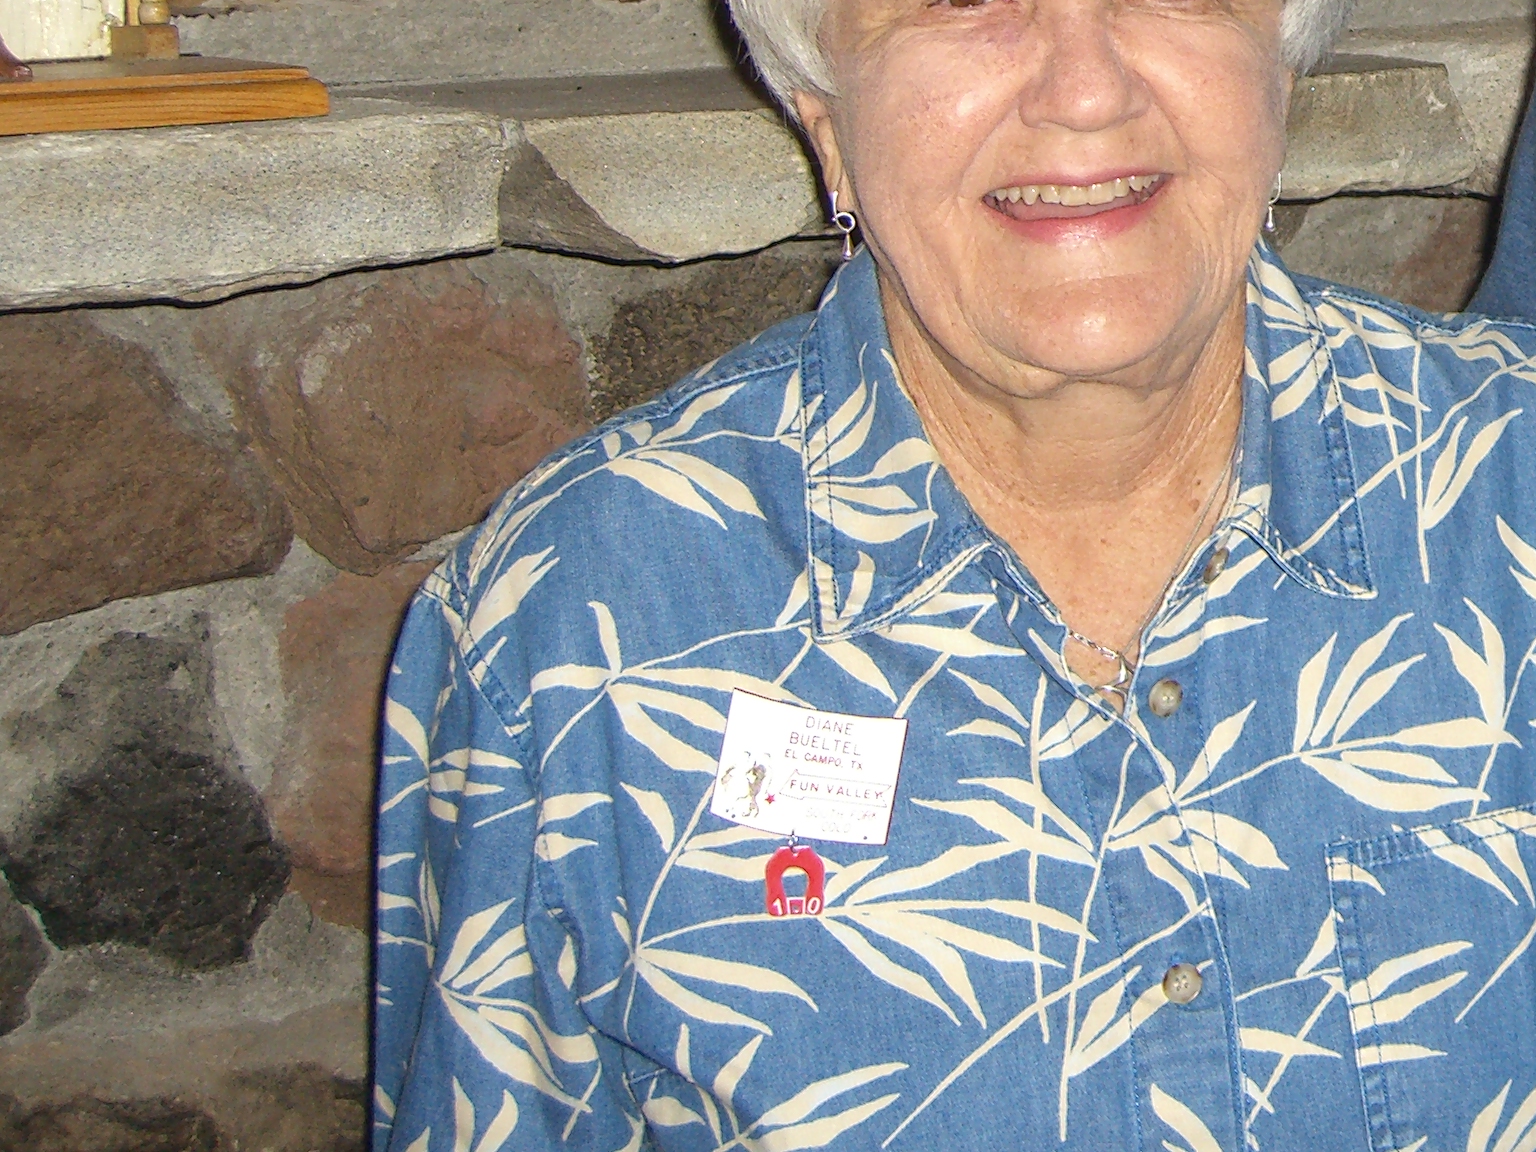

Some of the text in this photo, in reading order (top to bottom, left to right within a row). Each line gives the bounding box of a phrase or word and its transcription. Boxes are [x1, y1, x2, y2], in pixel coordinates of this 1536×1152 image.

[805, 715, 854, 736] DIANE
[789, 731, 861, 756] BUELTEL
[784, 748, 798, 759] EL
[851, 760, 863, 770] TX
[790, 779, 883, 799] FUN VALLEY
